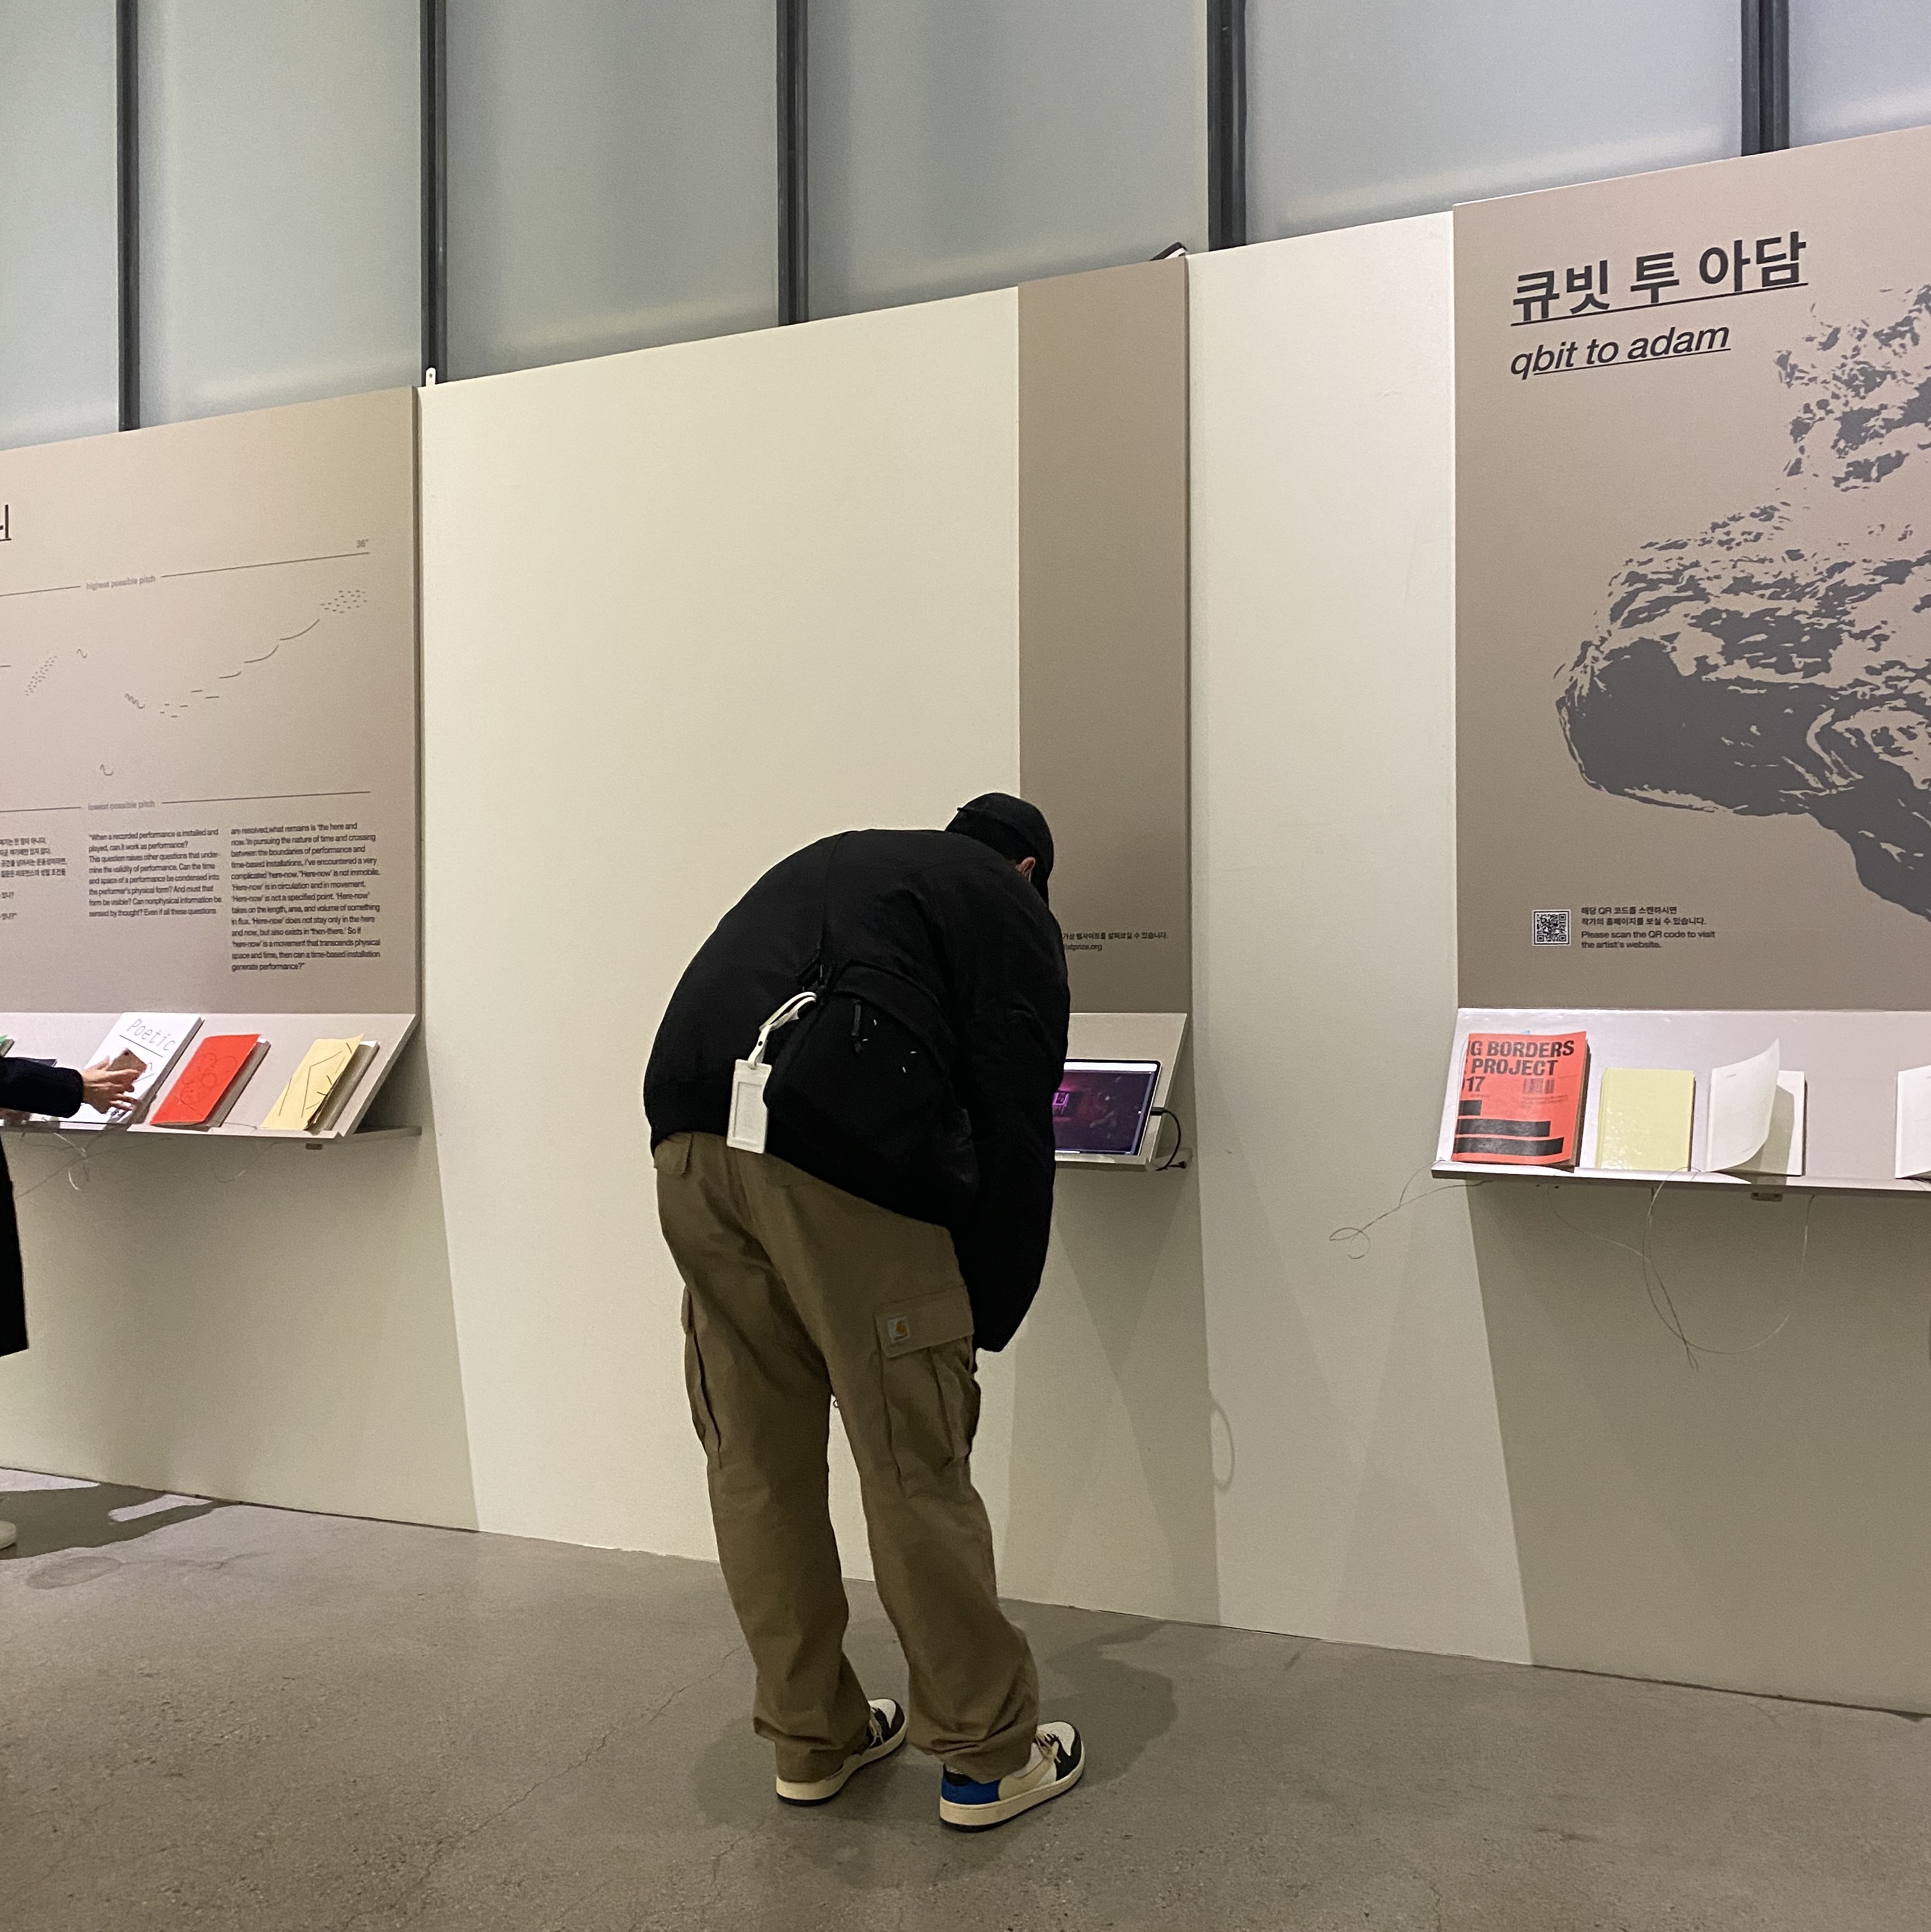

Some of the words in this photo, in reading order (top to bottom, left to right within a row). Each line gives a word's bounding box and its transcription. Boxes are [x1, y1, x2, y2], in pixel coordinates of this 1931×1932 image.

[1513, 260, 1610, 321] 큐빗
[1630, 252, 1679, 303] 투
[1699, 231, 1807, 292] 아담
[1510, 341, 1578, 380] qbit
[1587, 339, 1618, 365] to
[1628, 327, 1729, 361] adam
[126, 1019, 175, 1051] Poetic
[1487, 1040, 1575, 1058] BORDERS
[1471, 1058, 1558, 1076] PROJECT
